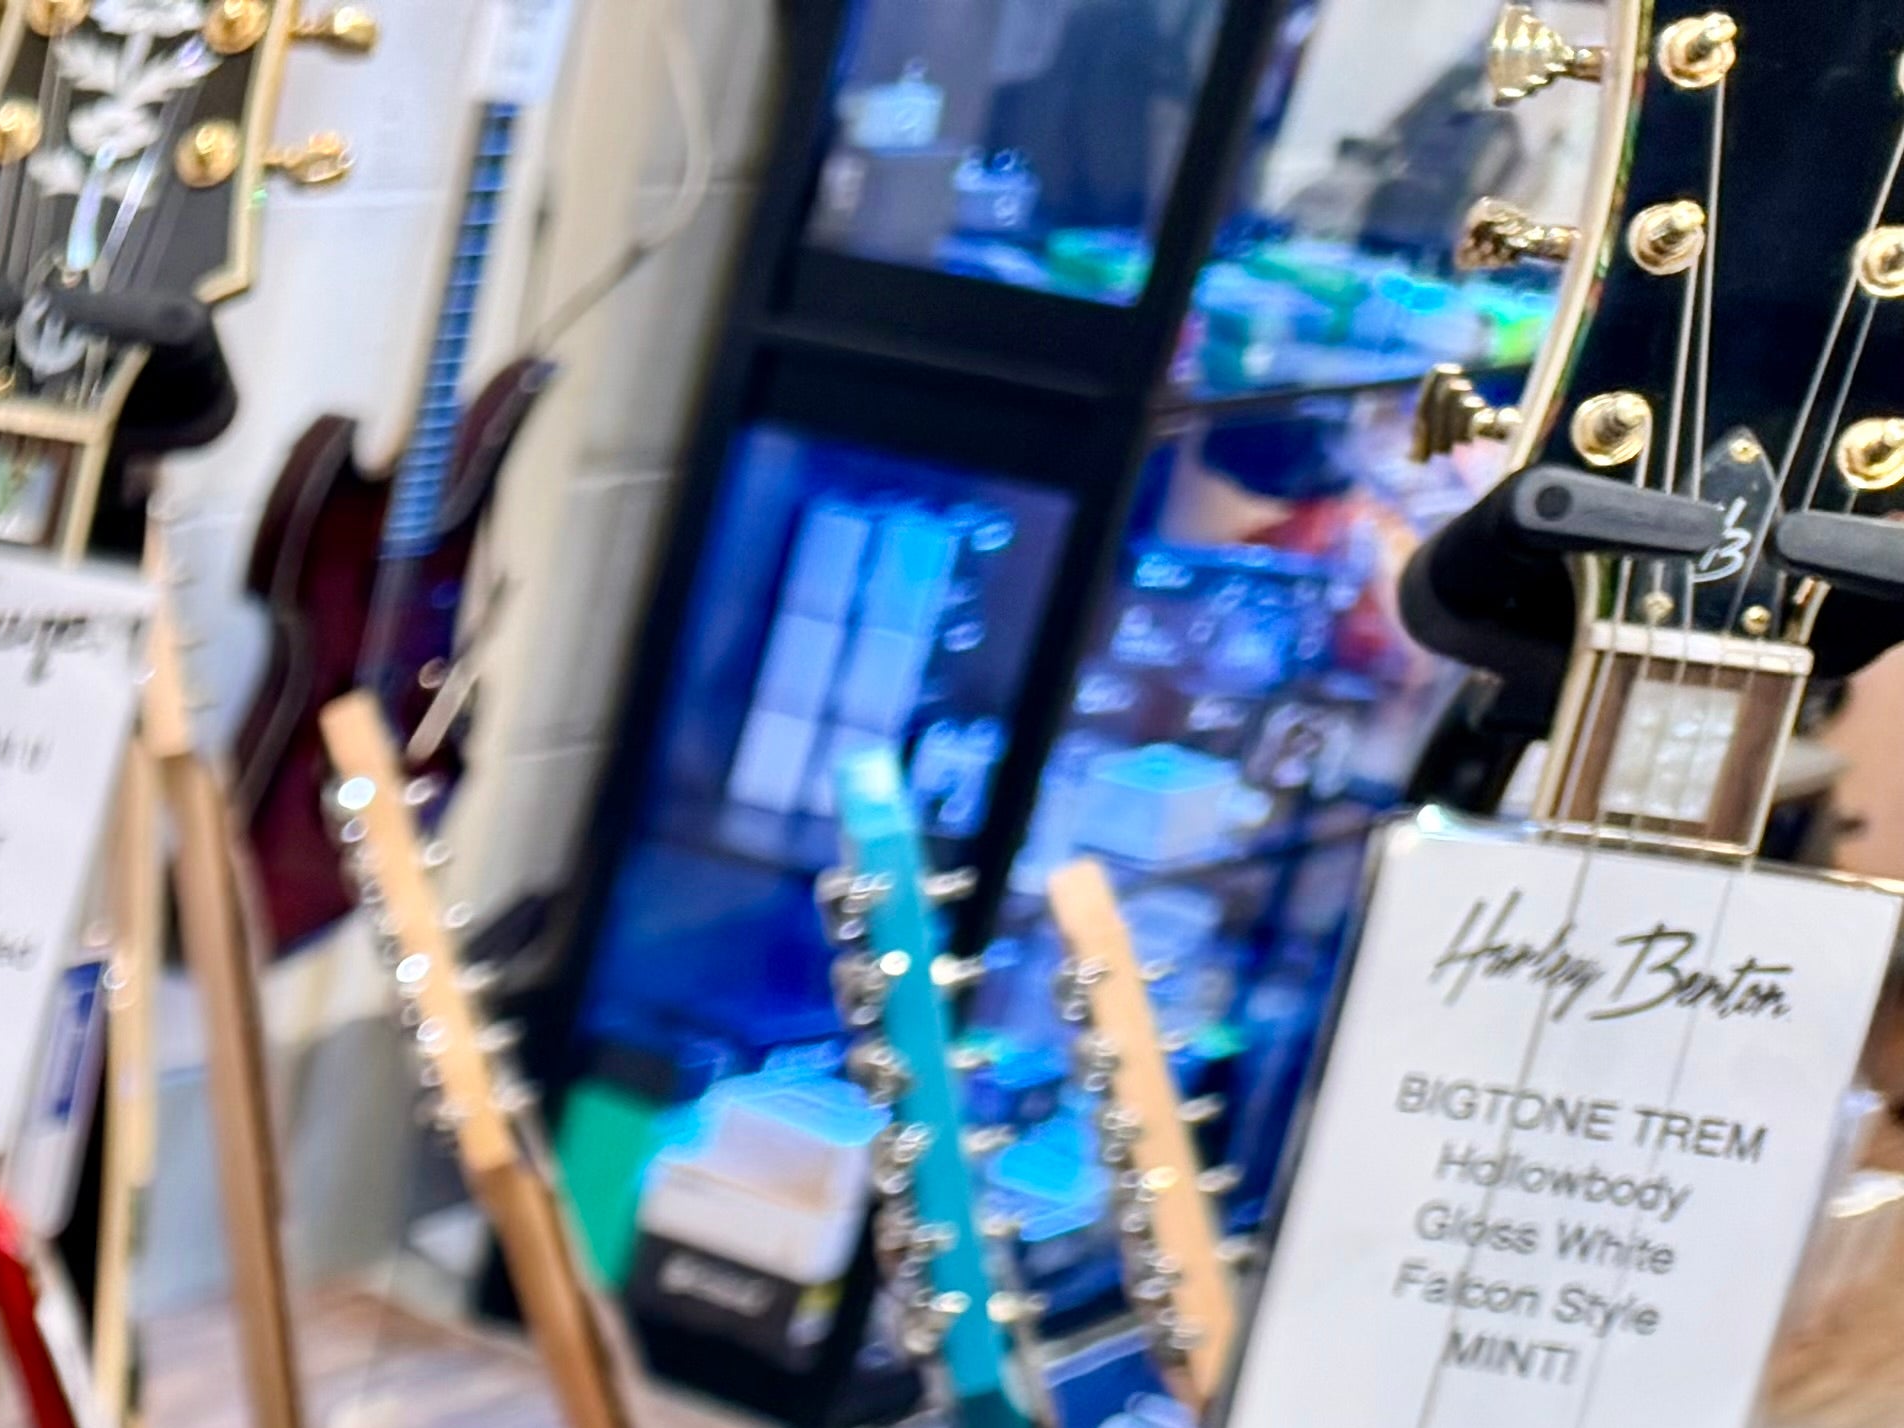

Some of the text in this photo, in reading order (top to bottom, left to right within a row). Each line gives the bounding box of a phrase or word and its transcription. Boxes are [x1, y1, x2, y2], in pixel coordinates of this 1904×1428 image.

[1428, 889, 1794, 1022] Harley Benton
[1396, 1072, 1769, 1163] BIGTONE TREM
[1435, 1141, 1694, 1223] Hollowbody
[1414, 1200, 1675, 1274] Gloss White
[1392, 1258, 1661, 1339] Falcon Style
